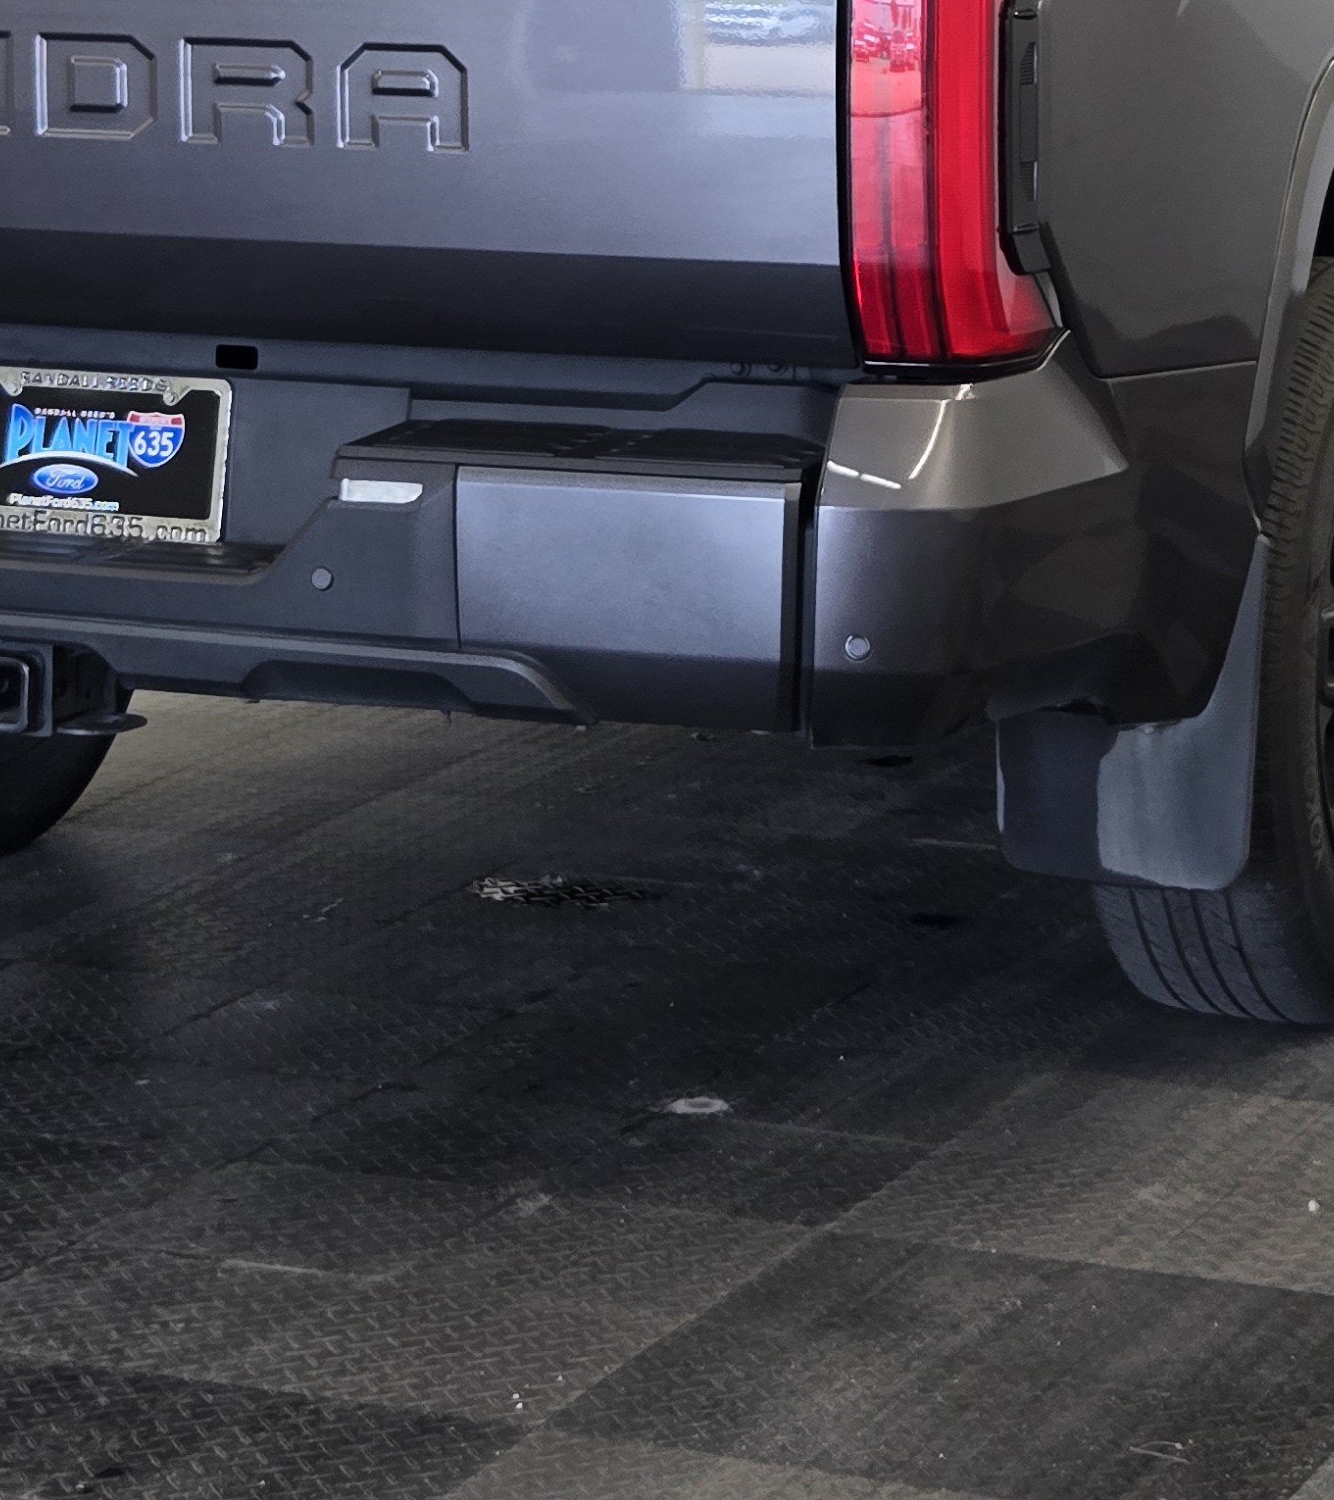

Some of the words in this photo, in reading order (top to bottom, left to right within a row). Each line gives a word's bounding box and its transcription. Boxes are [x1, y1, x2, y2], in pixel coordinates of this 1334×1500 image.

[5, 403, 135, 469] PLANET
[134, 431, 175, 457] 635
[46, 469, 85, 490] Ford
